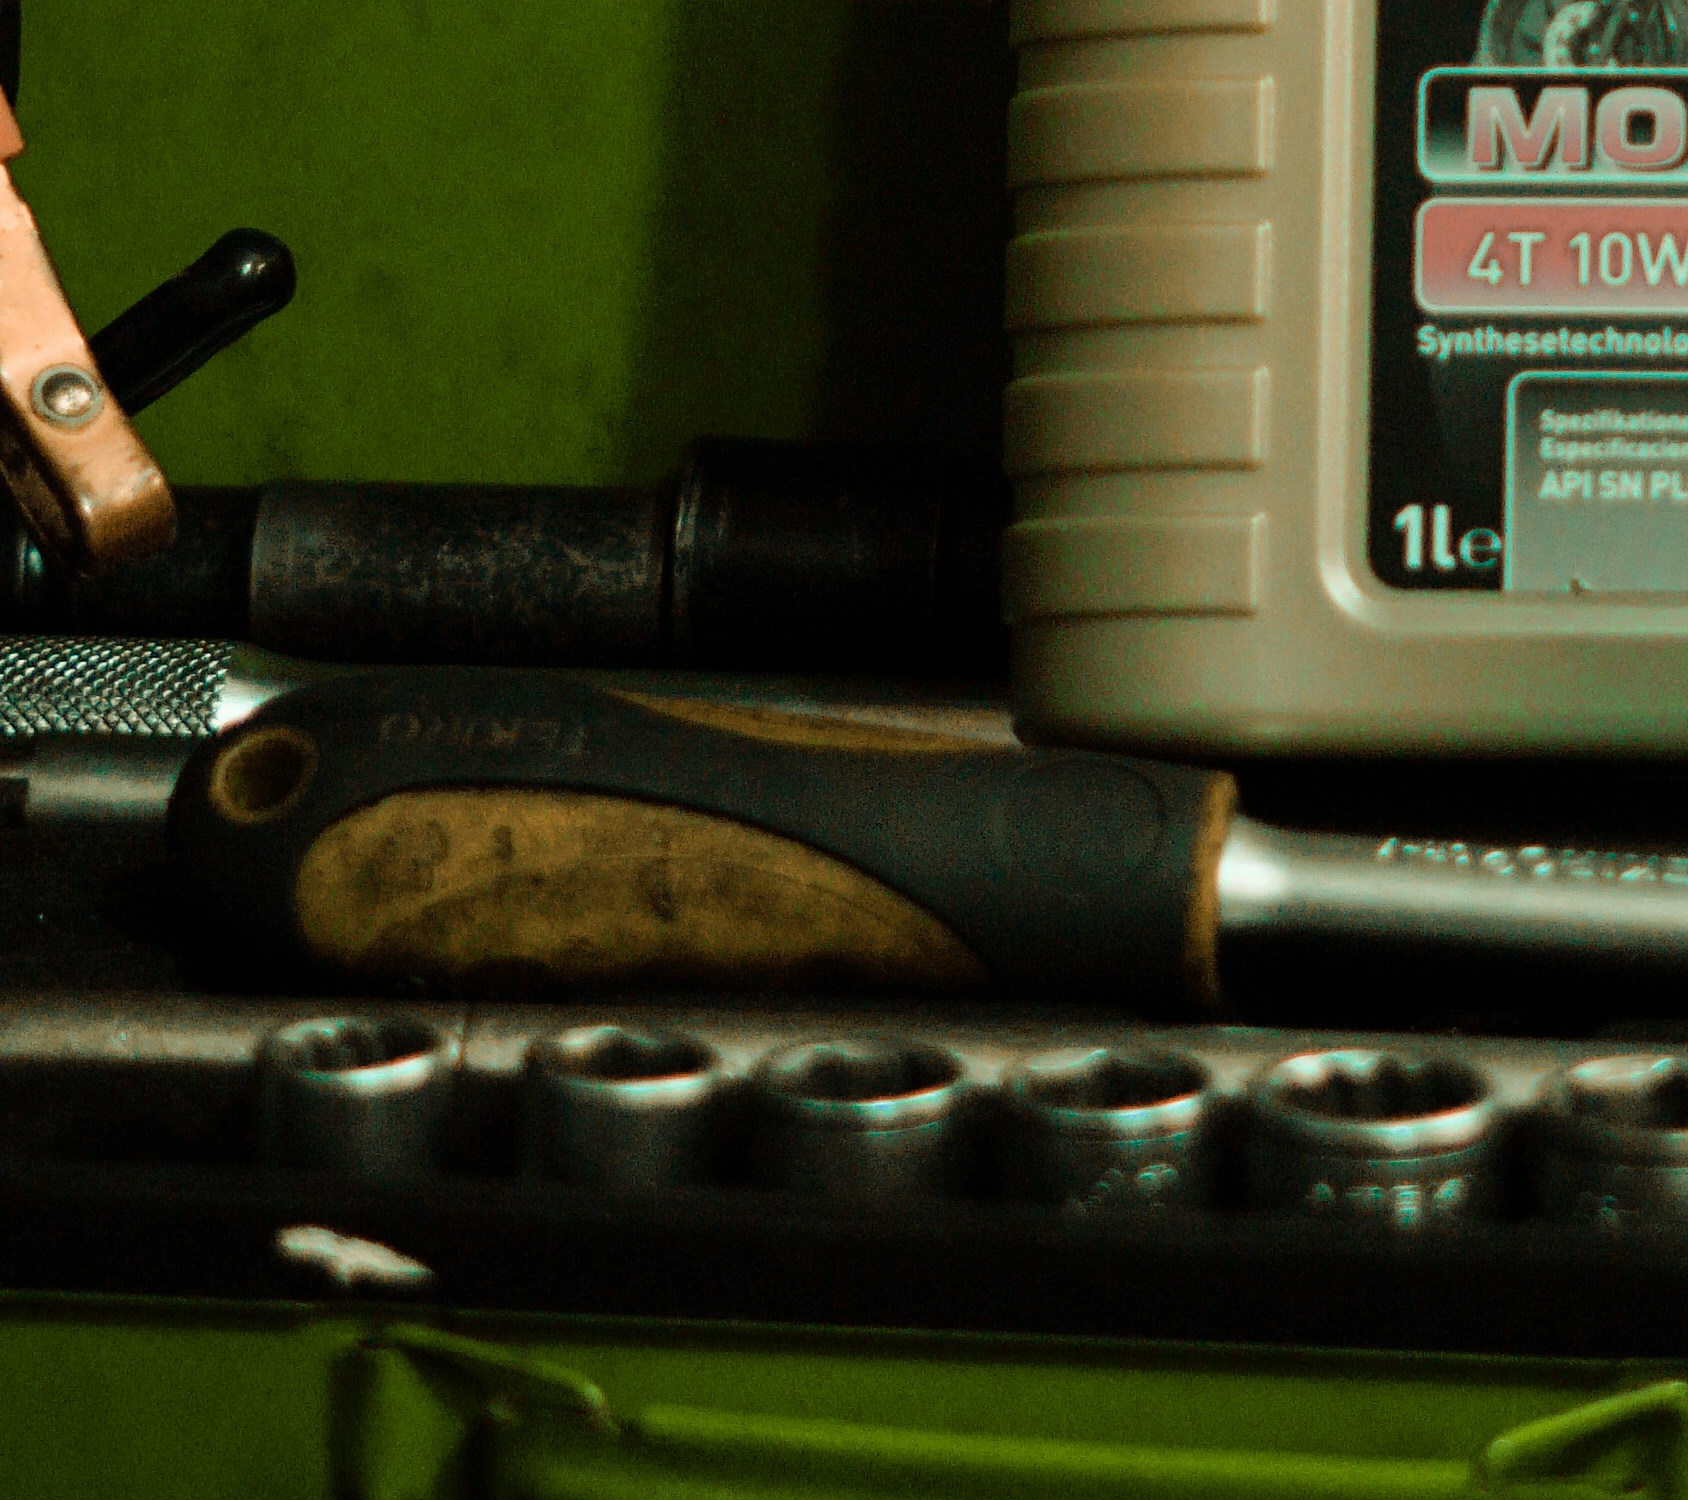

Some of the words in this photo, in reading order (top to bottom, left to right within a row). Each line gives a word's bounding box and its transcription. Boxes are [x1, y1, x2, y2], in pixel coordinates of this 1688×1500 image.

[1466, 231, 1544, 287] 4T
[1539, 470, 1593, 500] API
[1599, 470, 1643, 500] SN
